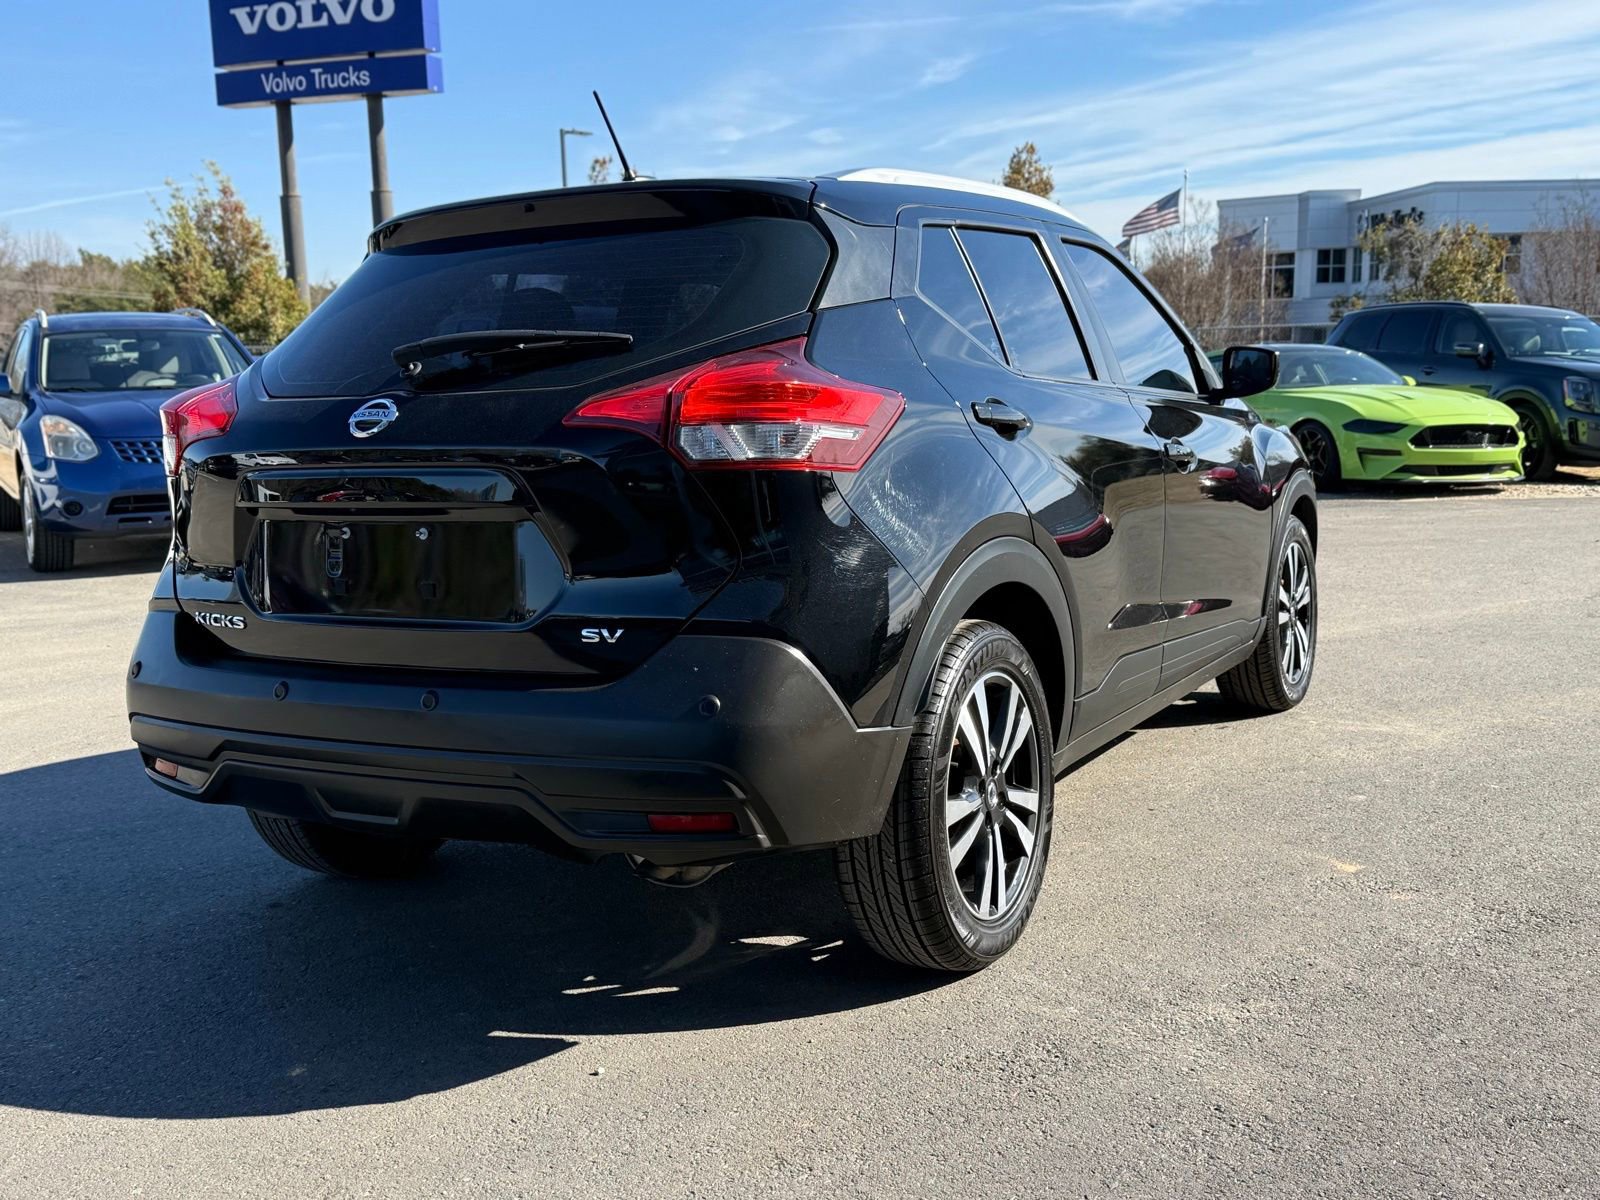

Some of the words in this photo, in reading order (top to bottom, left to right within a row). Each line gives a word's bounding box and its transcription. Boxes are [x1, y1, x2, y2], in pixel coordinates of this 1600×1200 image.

[230, 0, 395, 35] VOLVO
[261, 73, 307, 94] Volvo
[310, 66, 371, 89] Trucks
[352, 410, 390, 419] NISSAN
[195, 611, 245, 629] KICKS
[581, 628, 624, 643] SV
